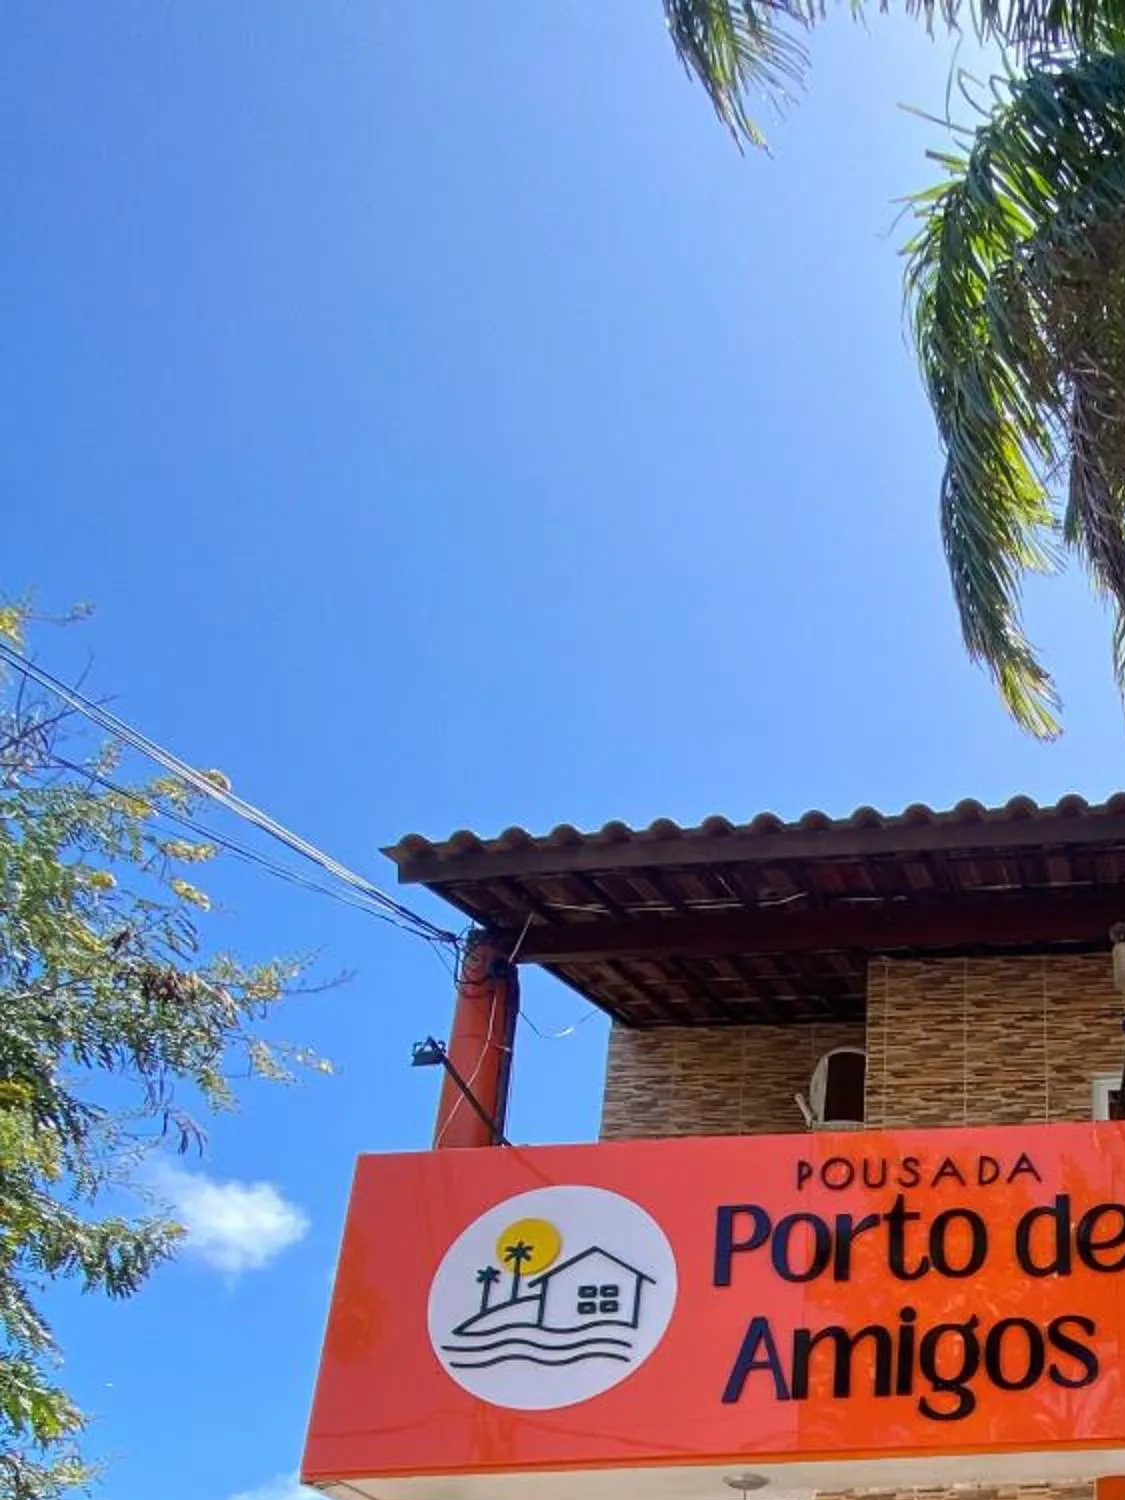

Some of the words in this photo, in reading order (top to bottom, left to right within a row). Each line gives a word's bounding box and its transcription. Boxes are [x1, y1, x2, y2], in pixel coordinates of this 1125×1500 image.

[797, 1152, 1042, 1191] POUSADA
[712, 1194, 988, 1287] Porto
[720, 1306, 1100, 1420] Amigos
